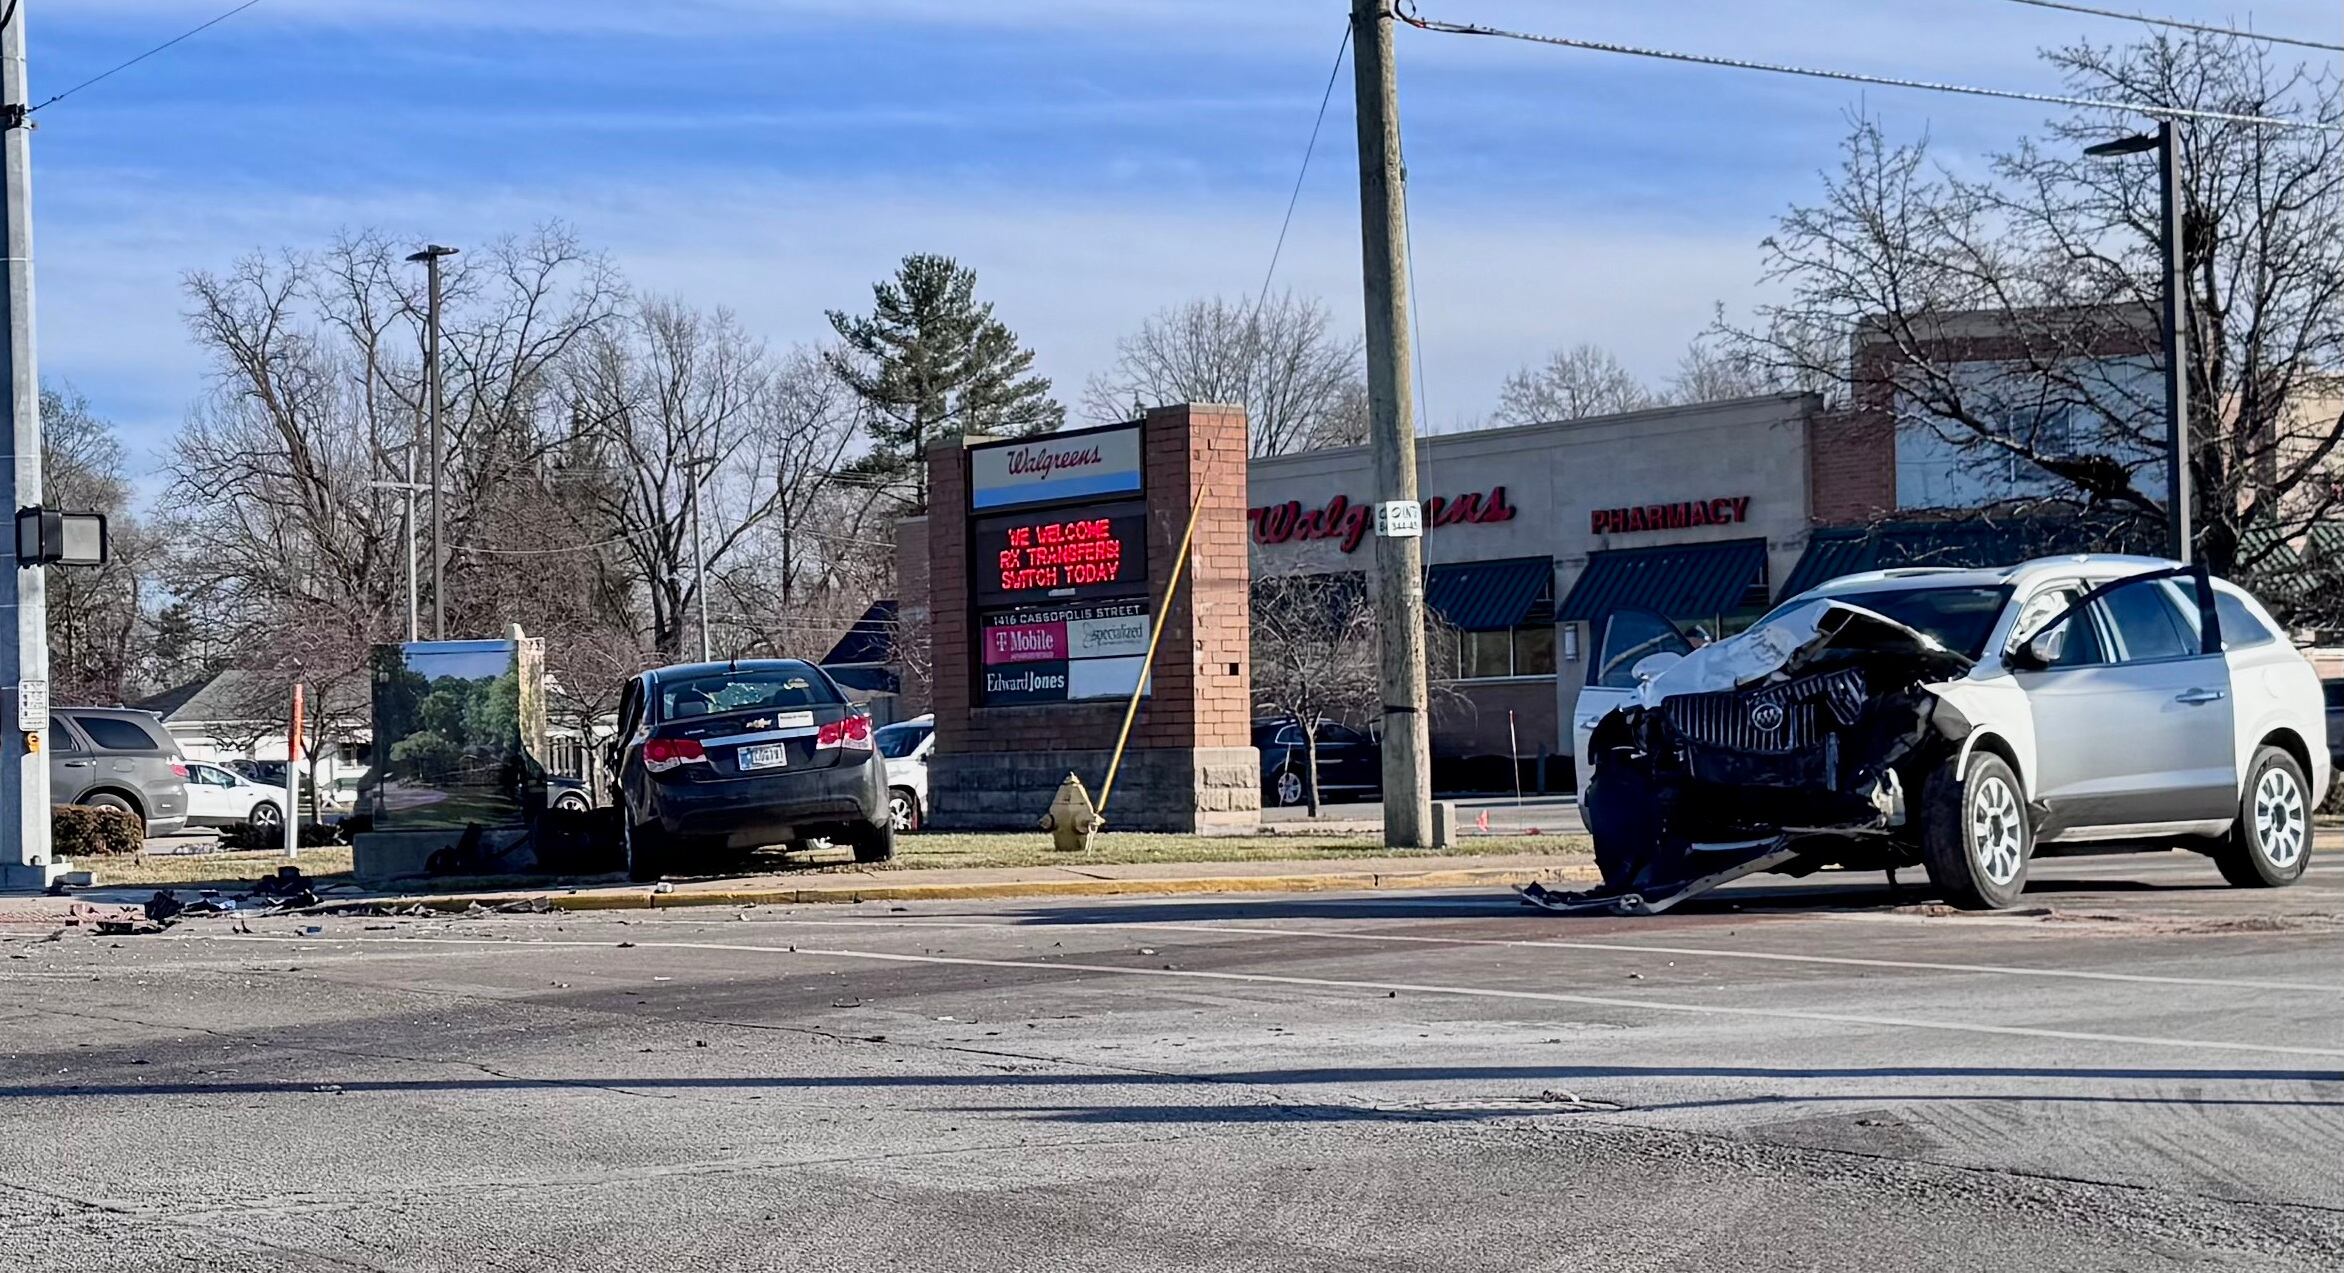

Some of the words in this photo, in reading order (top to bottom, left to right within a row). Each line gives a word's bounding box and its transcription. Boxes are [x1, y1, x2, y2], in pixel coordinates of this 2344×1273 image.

[1007, 445, 1102, 480] Walgreens
[1247, 486, 1517, 553] Walgens
[1591, 496, 1751, 534] PHARMACY
[1008, 526, 1031, 547] WE
[1036, 518, 1110, 545] WELCOME
[1000, 548, 1021, 569] RX
[1001, 566, 1057, 589] SWITCH
[1064, 561, 1119, 584] TODAY
[993, 615, 1018, 626] 1416
[1020, 608, 1093, 625] CASSOPOLIS
[1096, 604, 1140, 618] STREET
[1010, 630, 1054, 652] Mobile
